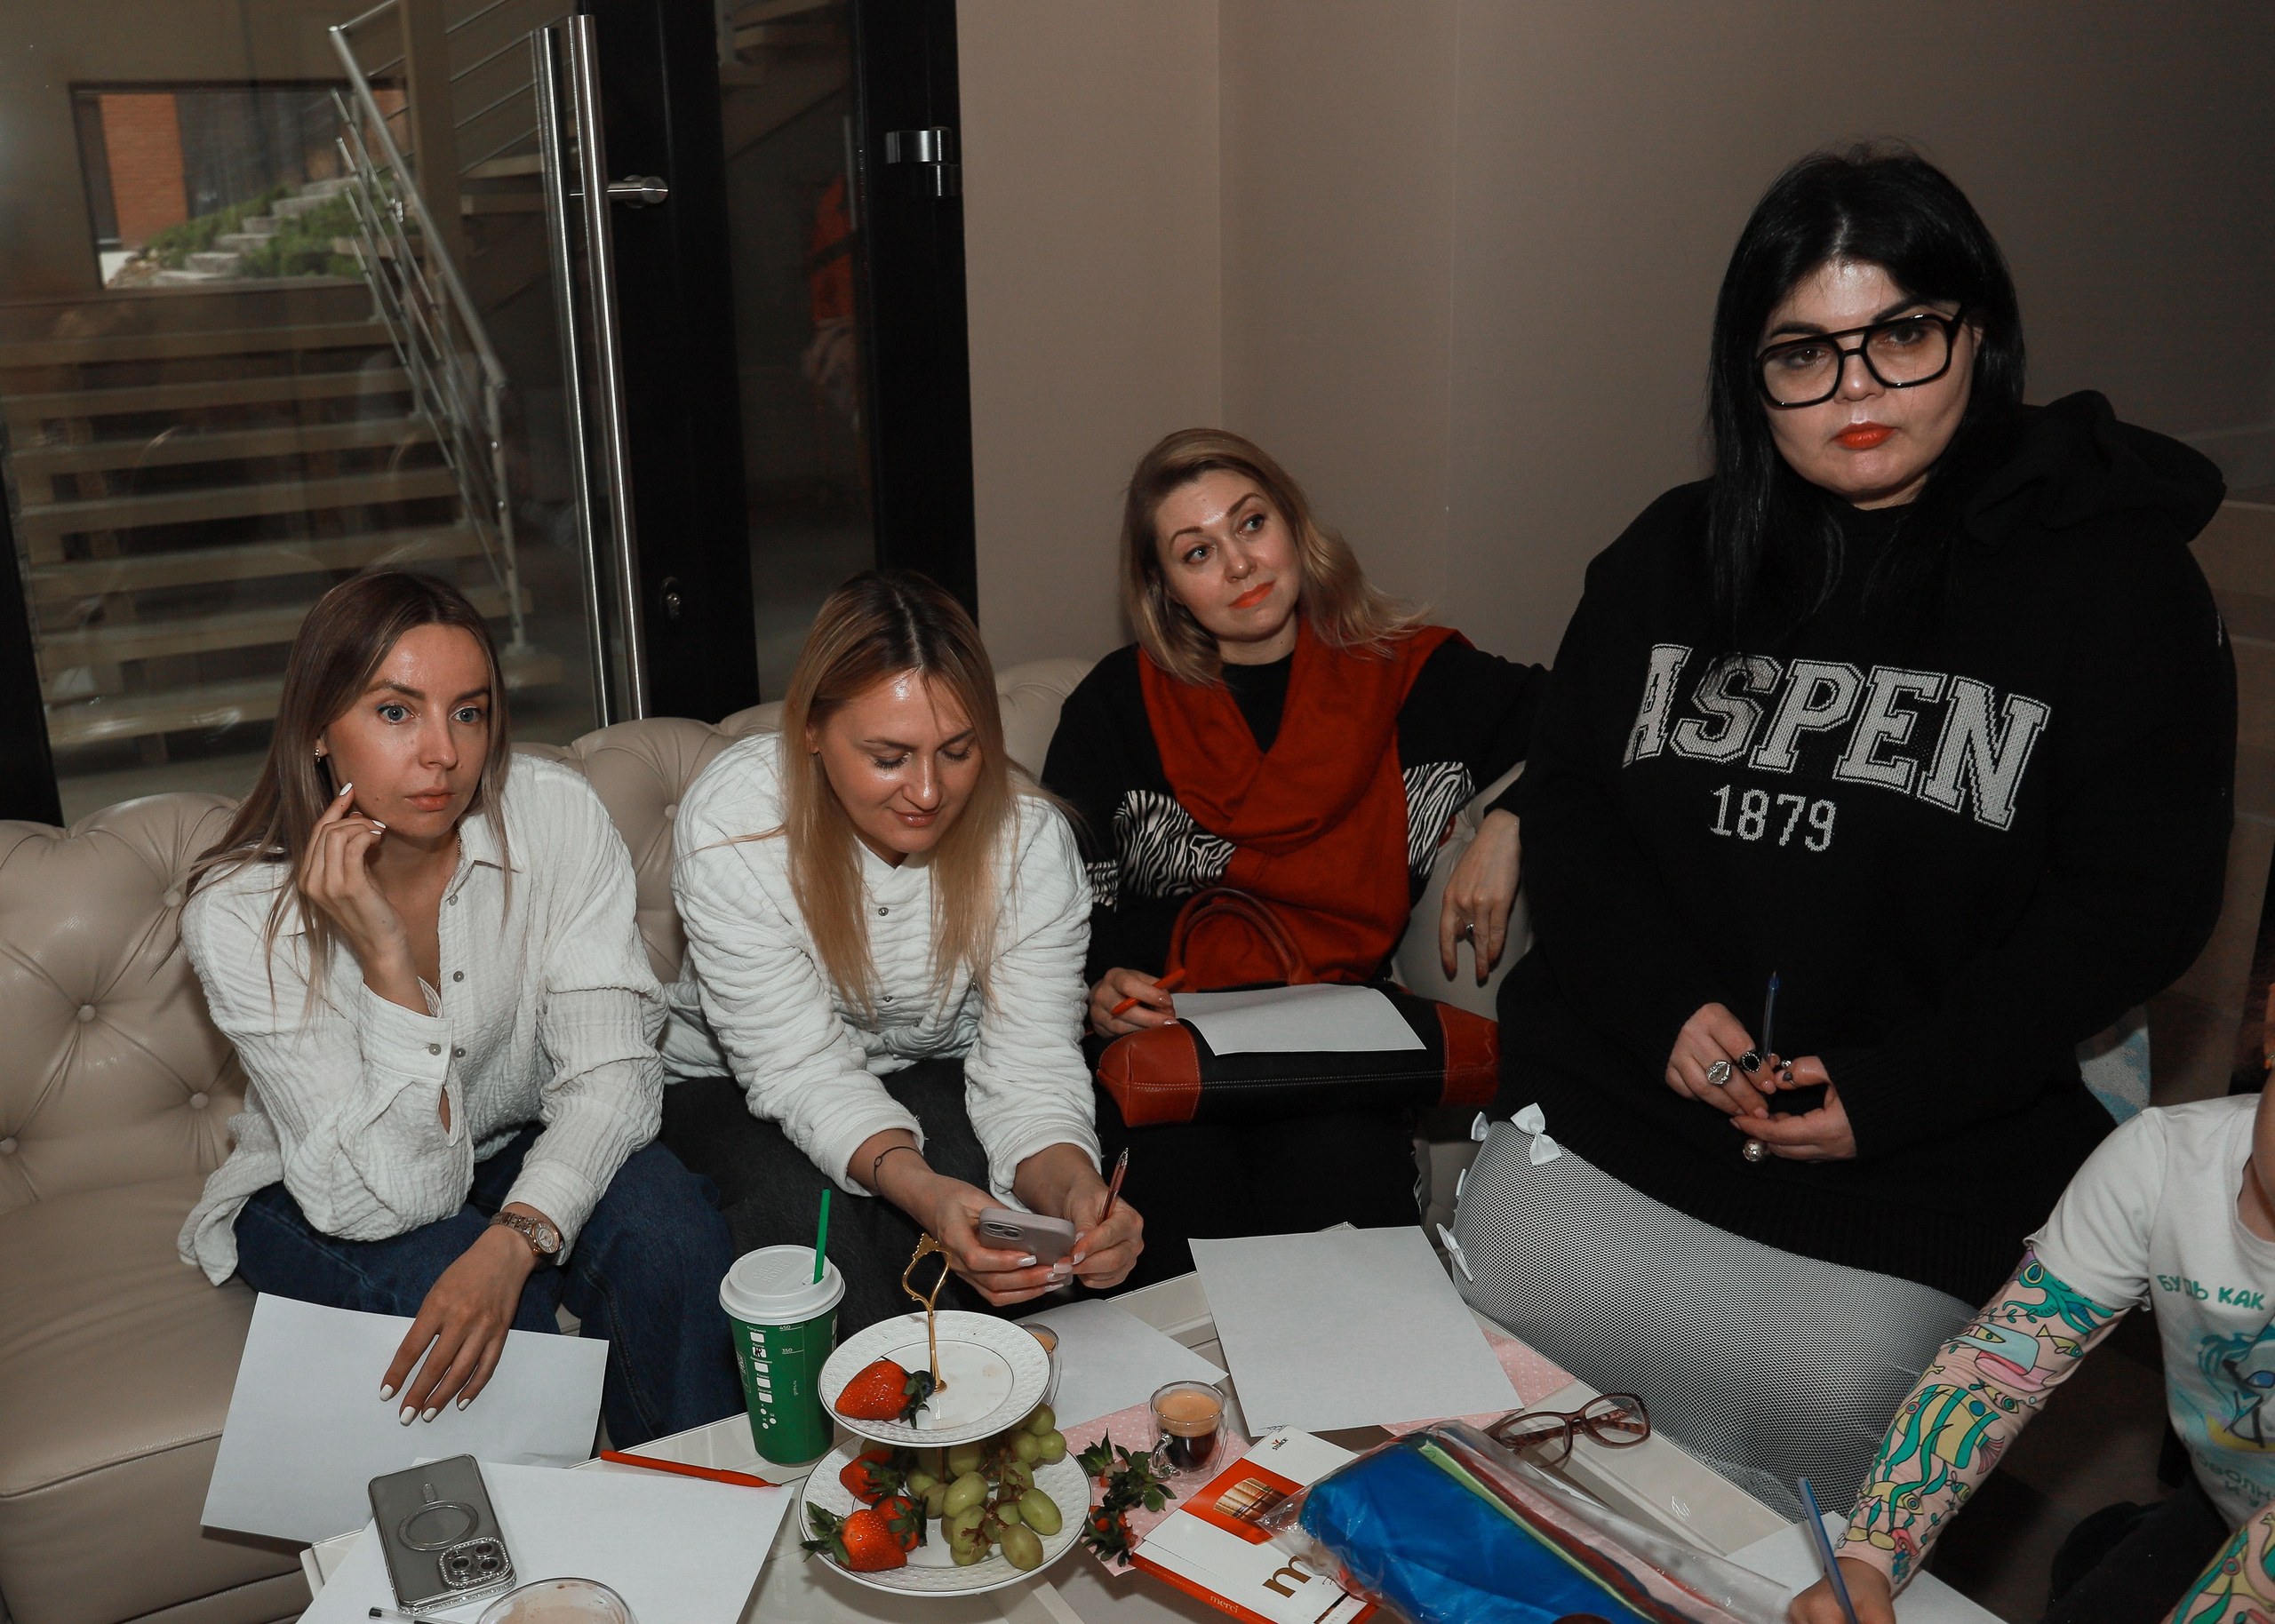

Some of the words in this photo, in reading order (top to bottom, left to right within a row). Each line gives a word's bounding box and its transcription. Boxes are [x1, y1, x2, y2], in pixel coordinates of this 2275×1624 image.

[1622, 643, 2051, 832] ASPEN
[1709, 784, 1837, 852] 1879
[2156, 1274, 2209, 1301] БУДЬ
[2217, 1286, 2265, 1311] КАК
[1209, 1595, 1239, 1614] merci
